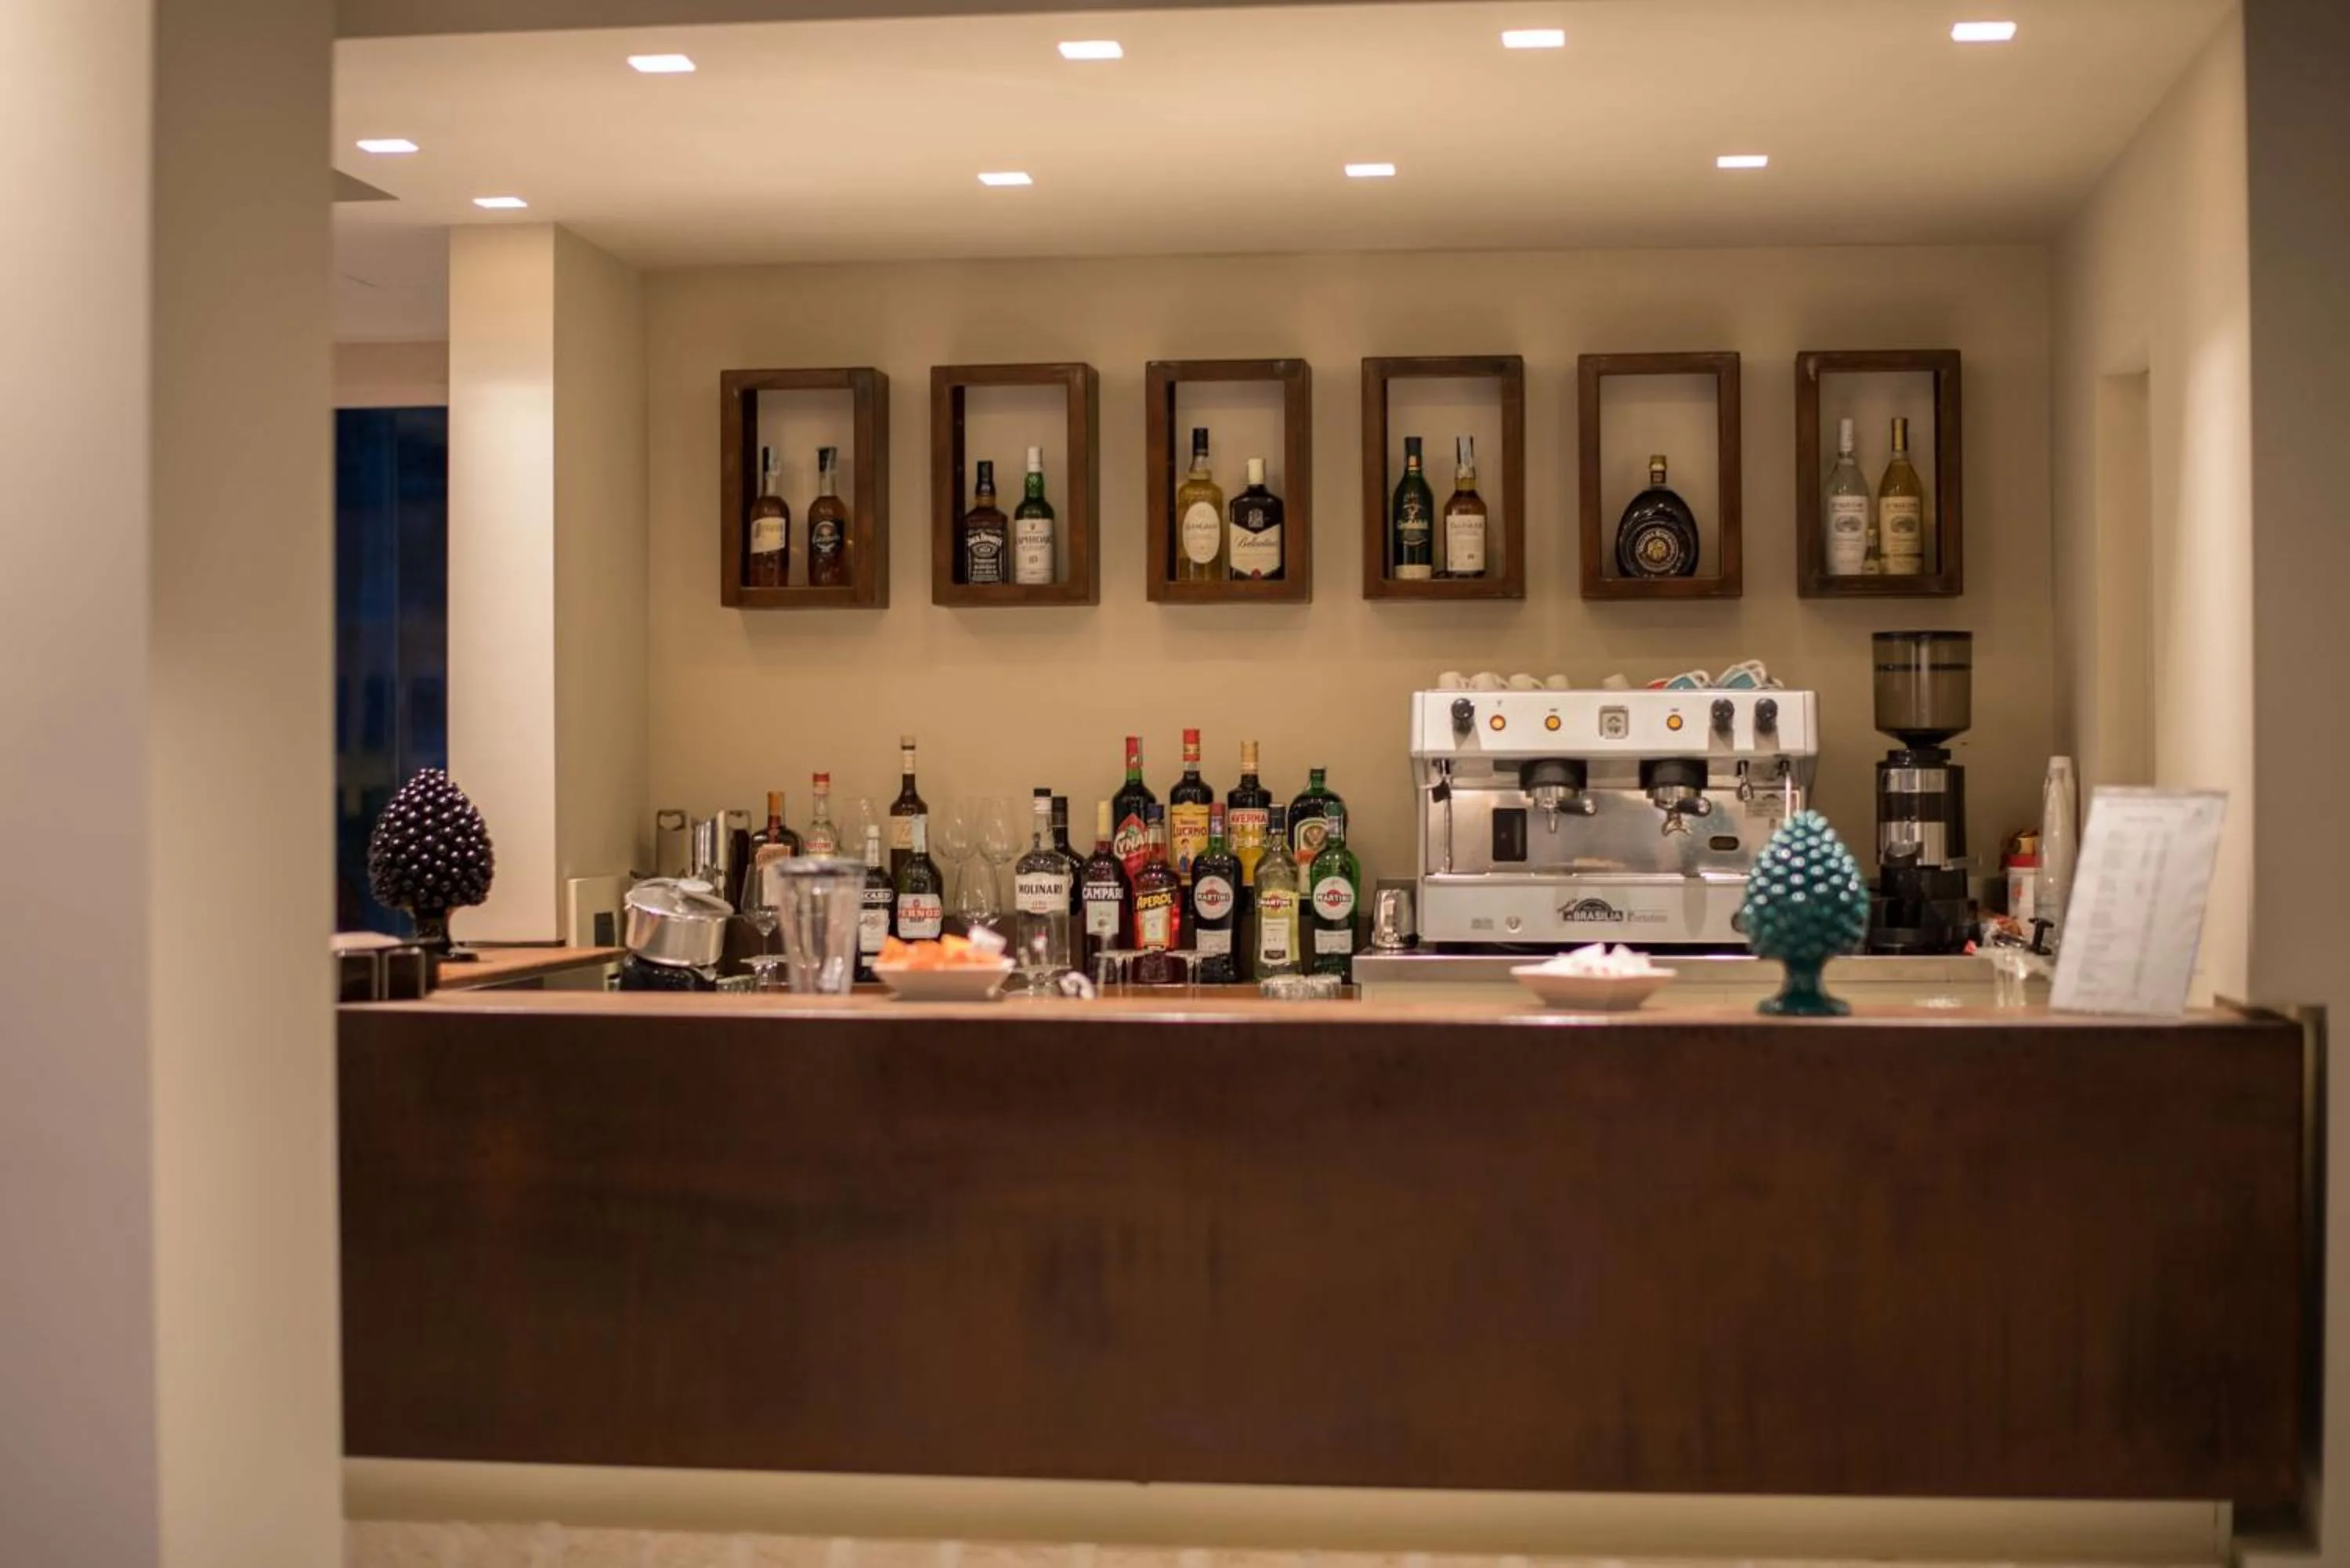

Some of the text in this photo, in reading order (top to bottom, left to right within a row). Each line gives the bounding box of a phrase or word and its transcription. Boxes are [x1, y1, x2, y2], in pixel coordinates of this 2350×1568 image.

[1231, 814, 1267, 823] AVERNA
[1018, 883, 1063, 894] MOLINARI
[1083, 887, 1124, 900] CAMPARI
[1137, 892, 1173, 909] APEROL
[1197, 893, 1231, 901] MARTINI
